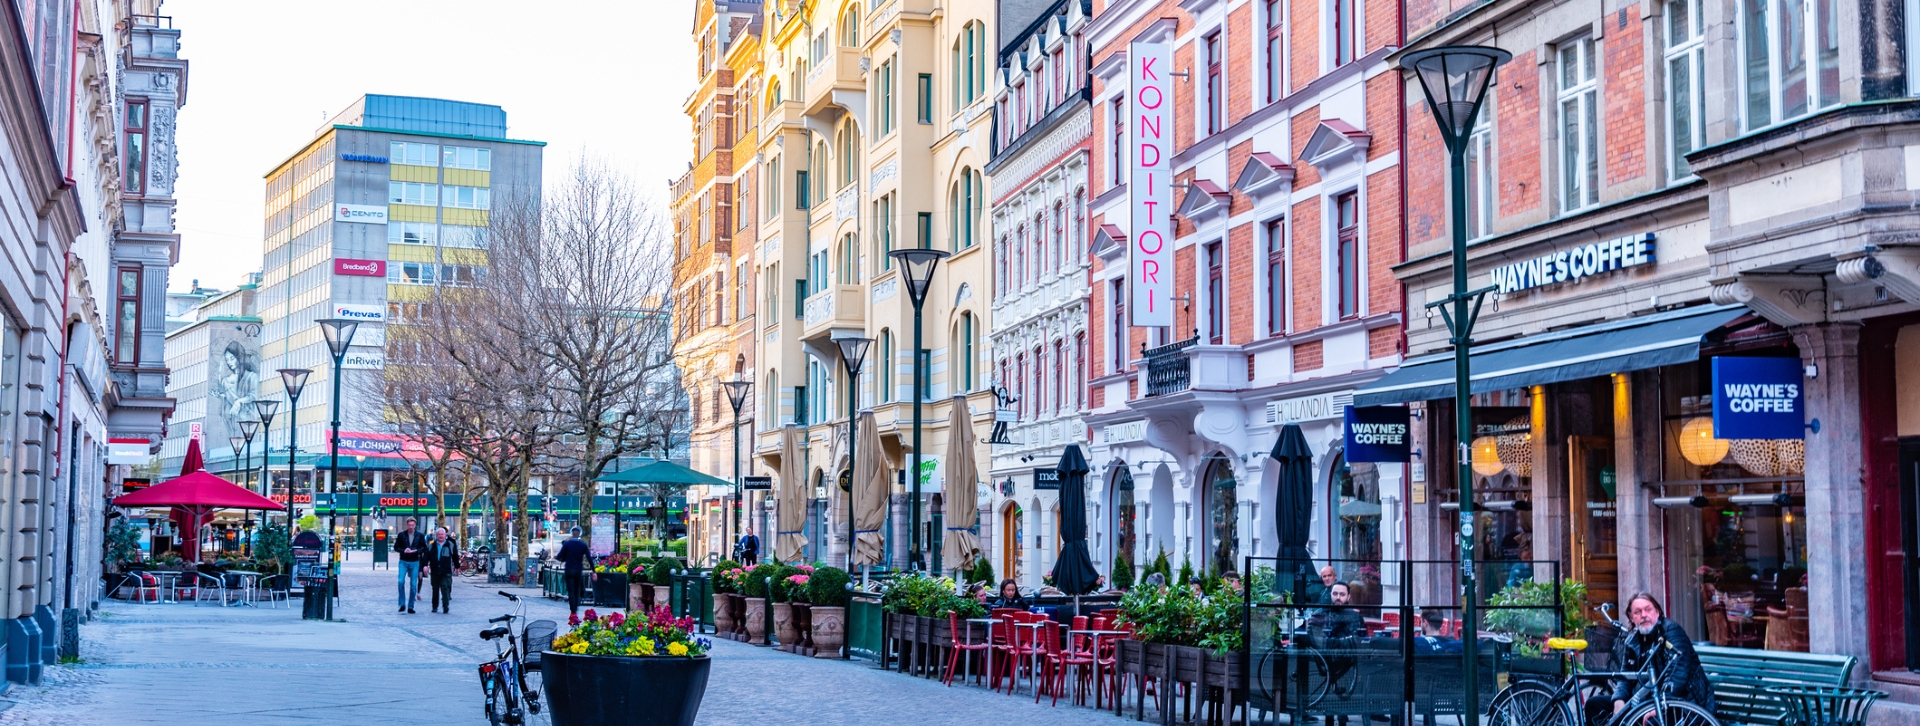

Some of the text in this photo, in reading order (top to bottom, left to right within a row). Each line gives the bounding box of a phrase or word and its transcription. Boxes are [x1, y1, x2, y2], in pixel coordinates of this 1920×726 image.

[1139, 57, 1162, 313] KONDITORI
[351, 210, 384, 218] CENITO
[1490, 232, 1655, 295] WAYNE'S COFFEE
[342, 309, 382, 318] Prevas
[346, 356, 381, 366] inRiver
[1724, 383, 1799, 399] WAYNE'S
[1277, 397, 1330, 423] HOLLANDIA
[1729, 398, 1794, 413] COFFEE
[1351, 422, 1406, 435] WAYNE'S
[1354, 433, 1403, 445] COFFEE
